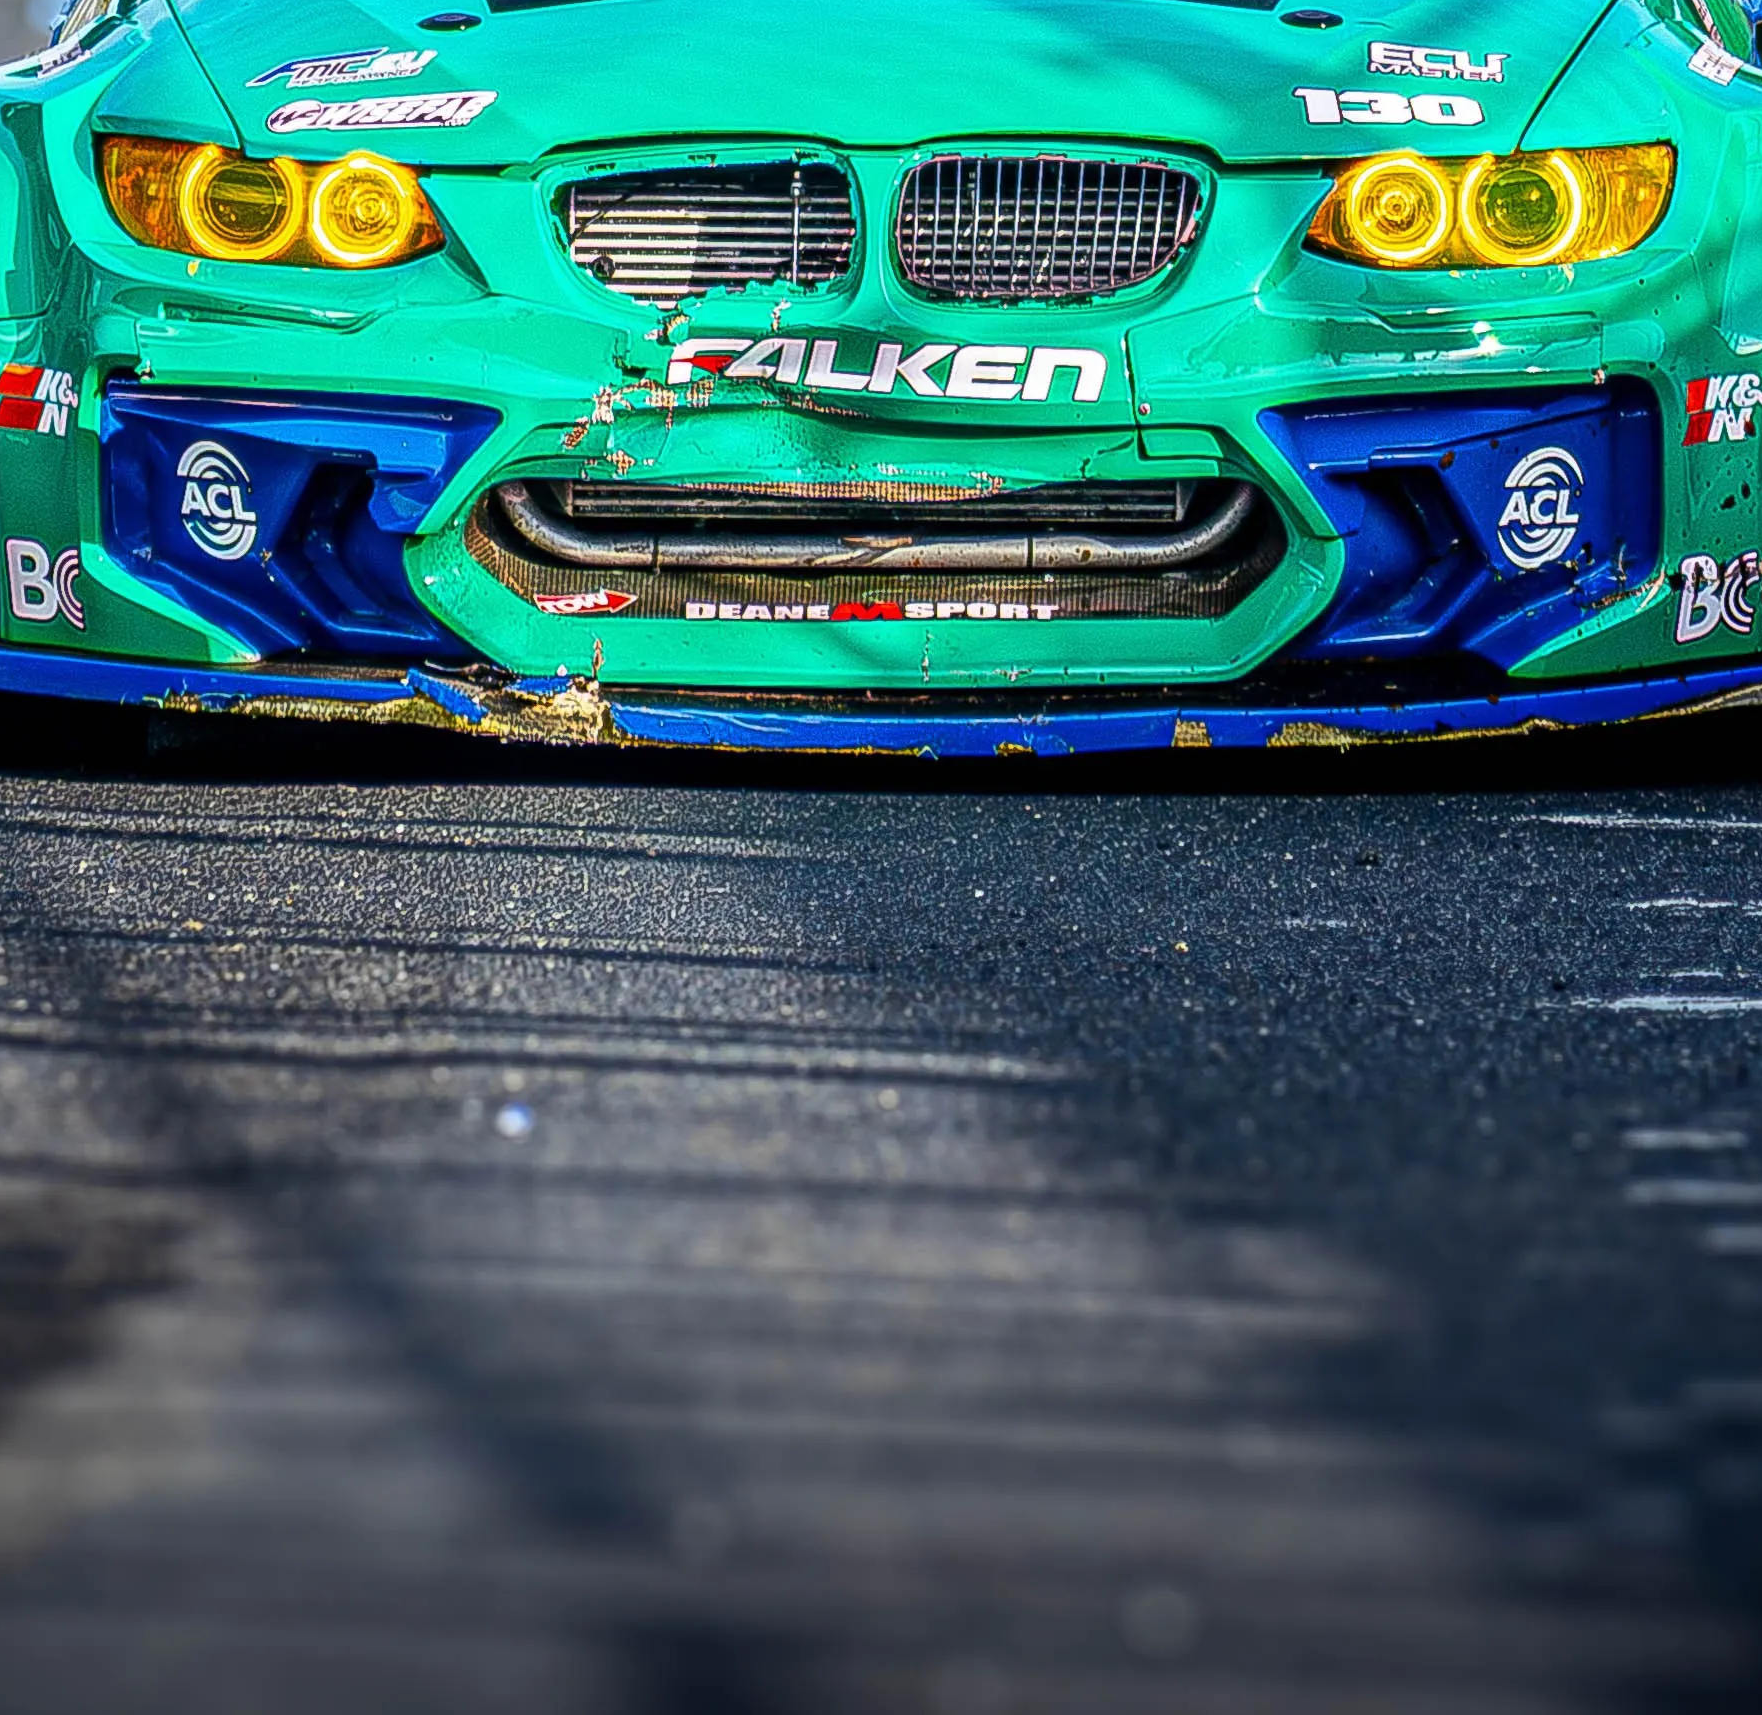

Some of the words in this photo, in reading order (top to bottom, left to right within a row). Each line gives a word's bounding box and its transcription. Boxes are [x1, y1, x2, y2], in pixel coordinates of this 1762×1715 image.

[1369, 42, 1511, 72] ECU
[1294, 88, 1485, 125] 130
[666, 338, 1106, 401] FALKEN
[181, 482, 256, 522] ACL
[1498, 489, 1580, 526] ACL
[538, 587, 608, 614] TOW
